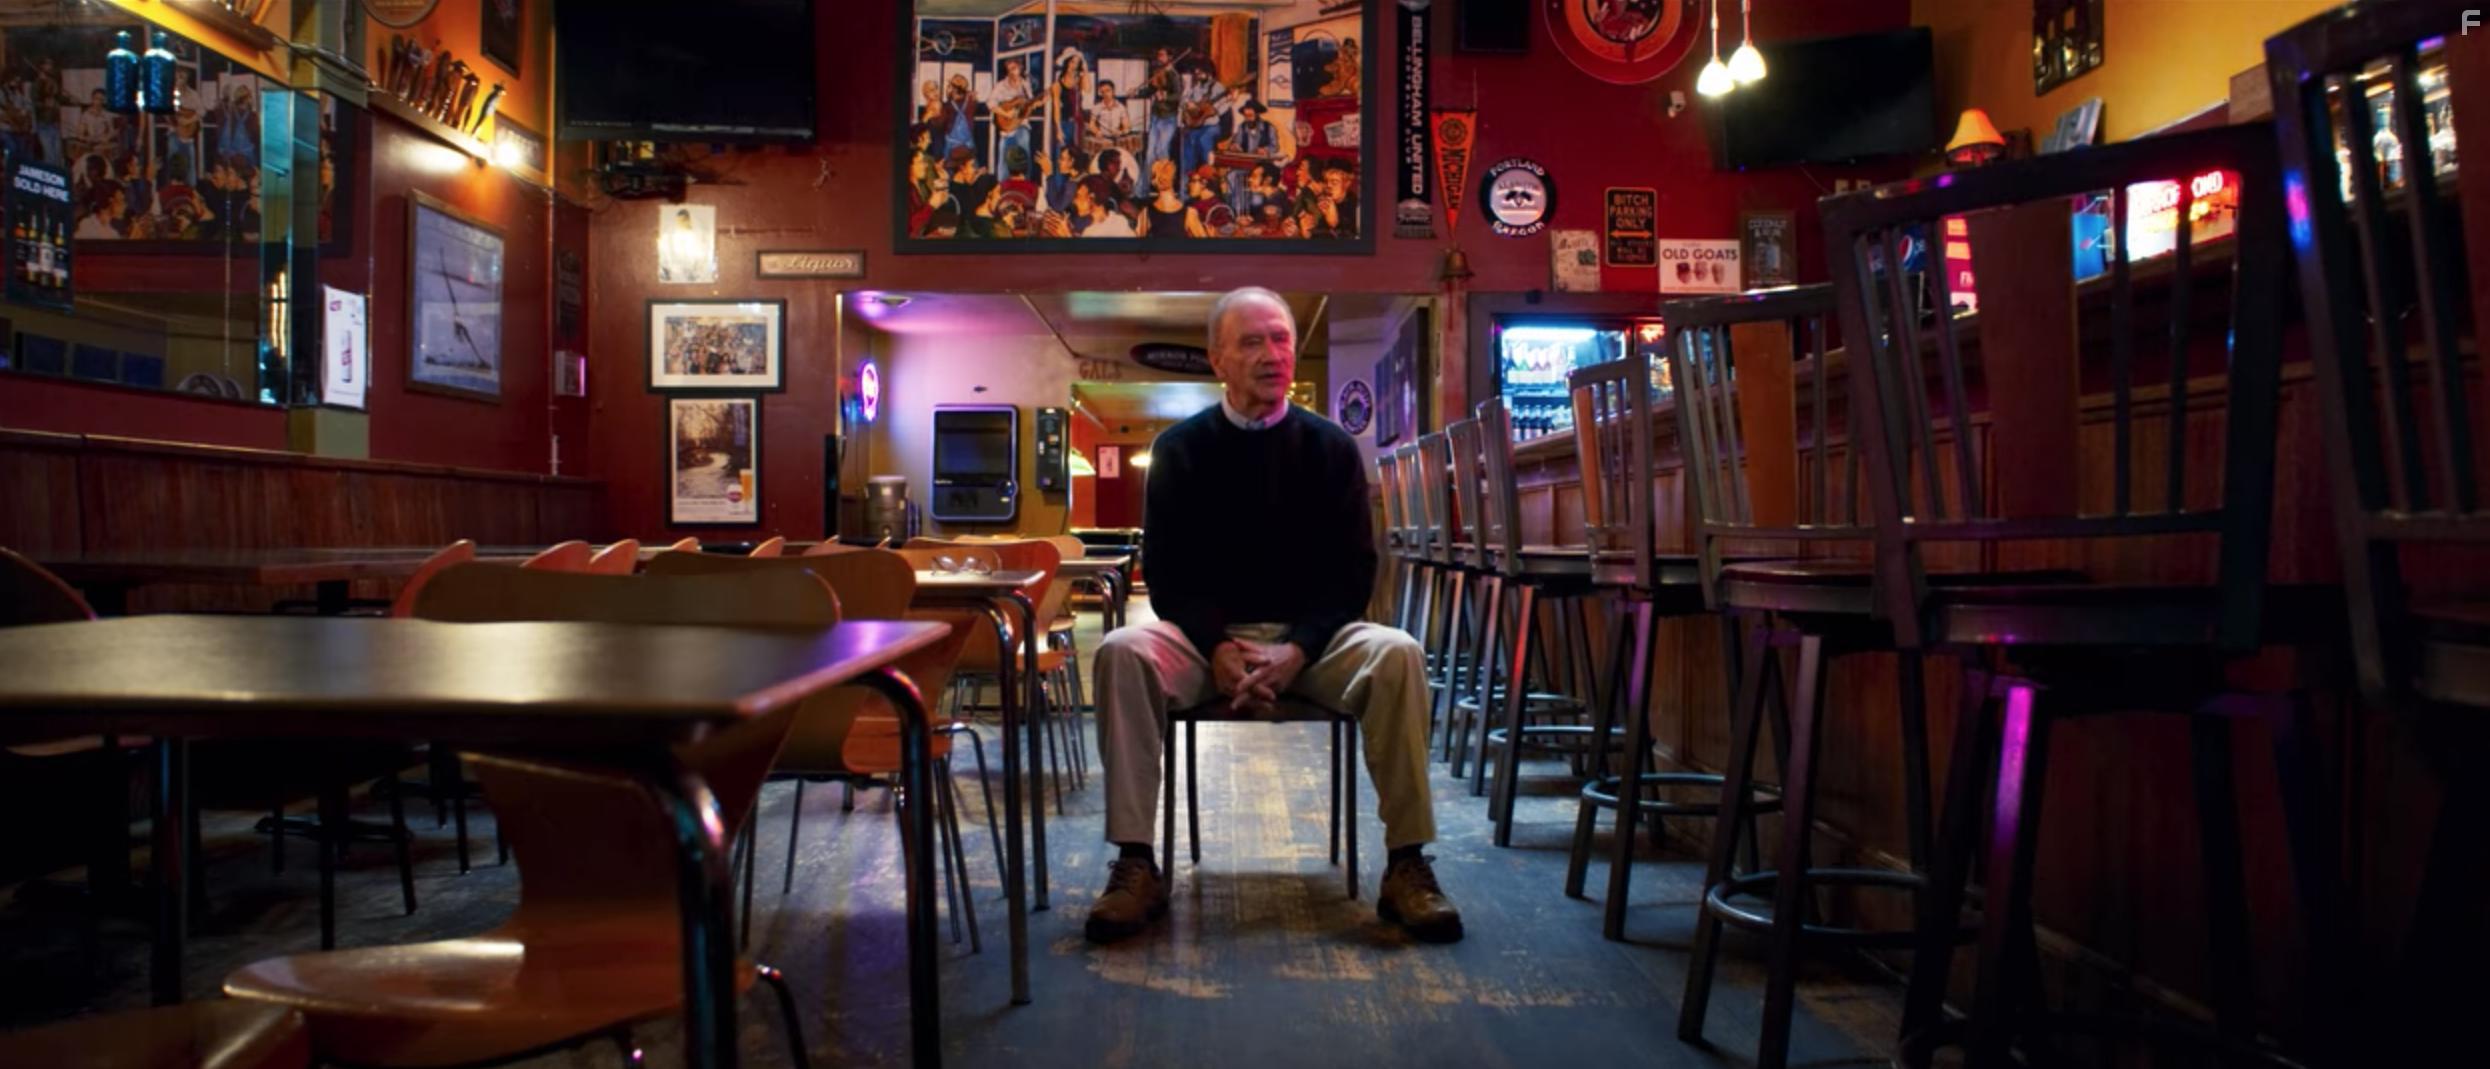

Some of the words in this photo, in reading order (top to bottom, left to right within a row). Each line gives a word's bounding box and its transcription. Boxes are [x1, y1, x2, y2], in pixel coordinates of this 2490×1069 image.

[1411, 15, 1422, 126] BELLINGHAM
[1411, 134, 1422, 194] UNITED
[1489, 159, 1545, 177] PORTLAND
[18, 164, 66, 188] JAMESON
[1441, 148, 1466, 209] MICHIGAN
[14, 176, 41, 195] SOLD
[42, 184, 70, 203] HERE
[1614, 194, 1648, 206] BITCH
[1610, 206, 1653, 217] PARKING
[1616, 218, 1647, 229] ONLY
[1662, 248, 1689, 260] OLD
[1693, 248, 1738, 260] GOATS
[1079, 360, 1122, 379] GALS
